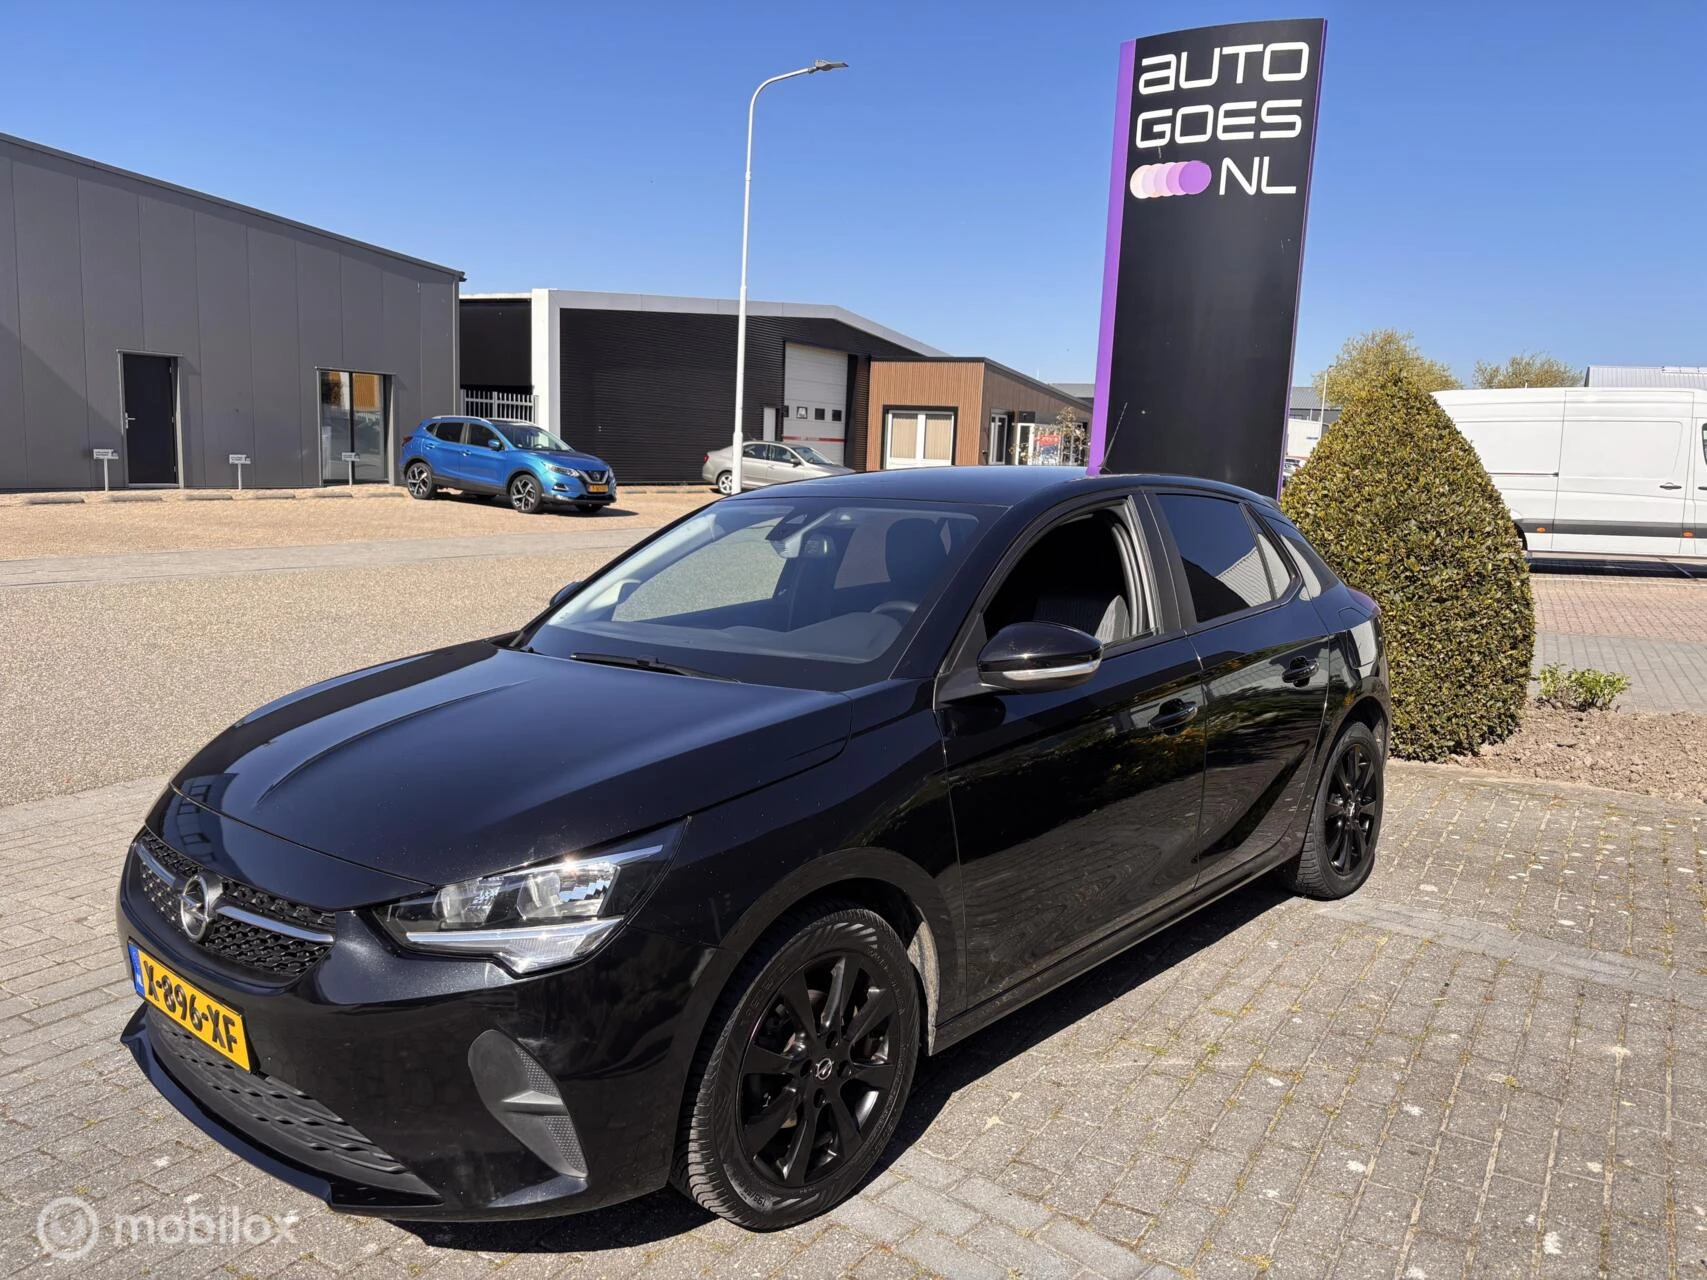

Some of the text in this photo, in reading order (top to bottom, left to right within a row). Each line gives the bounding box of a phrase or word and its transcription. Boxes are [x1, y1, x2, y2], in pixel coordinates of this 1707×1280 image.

[1135, 99, 1303, 149] GOES
[1219, 156, 1297, 196] NL
[143, 960, 238, 1054] X-896-XF
